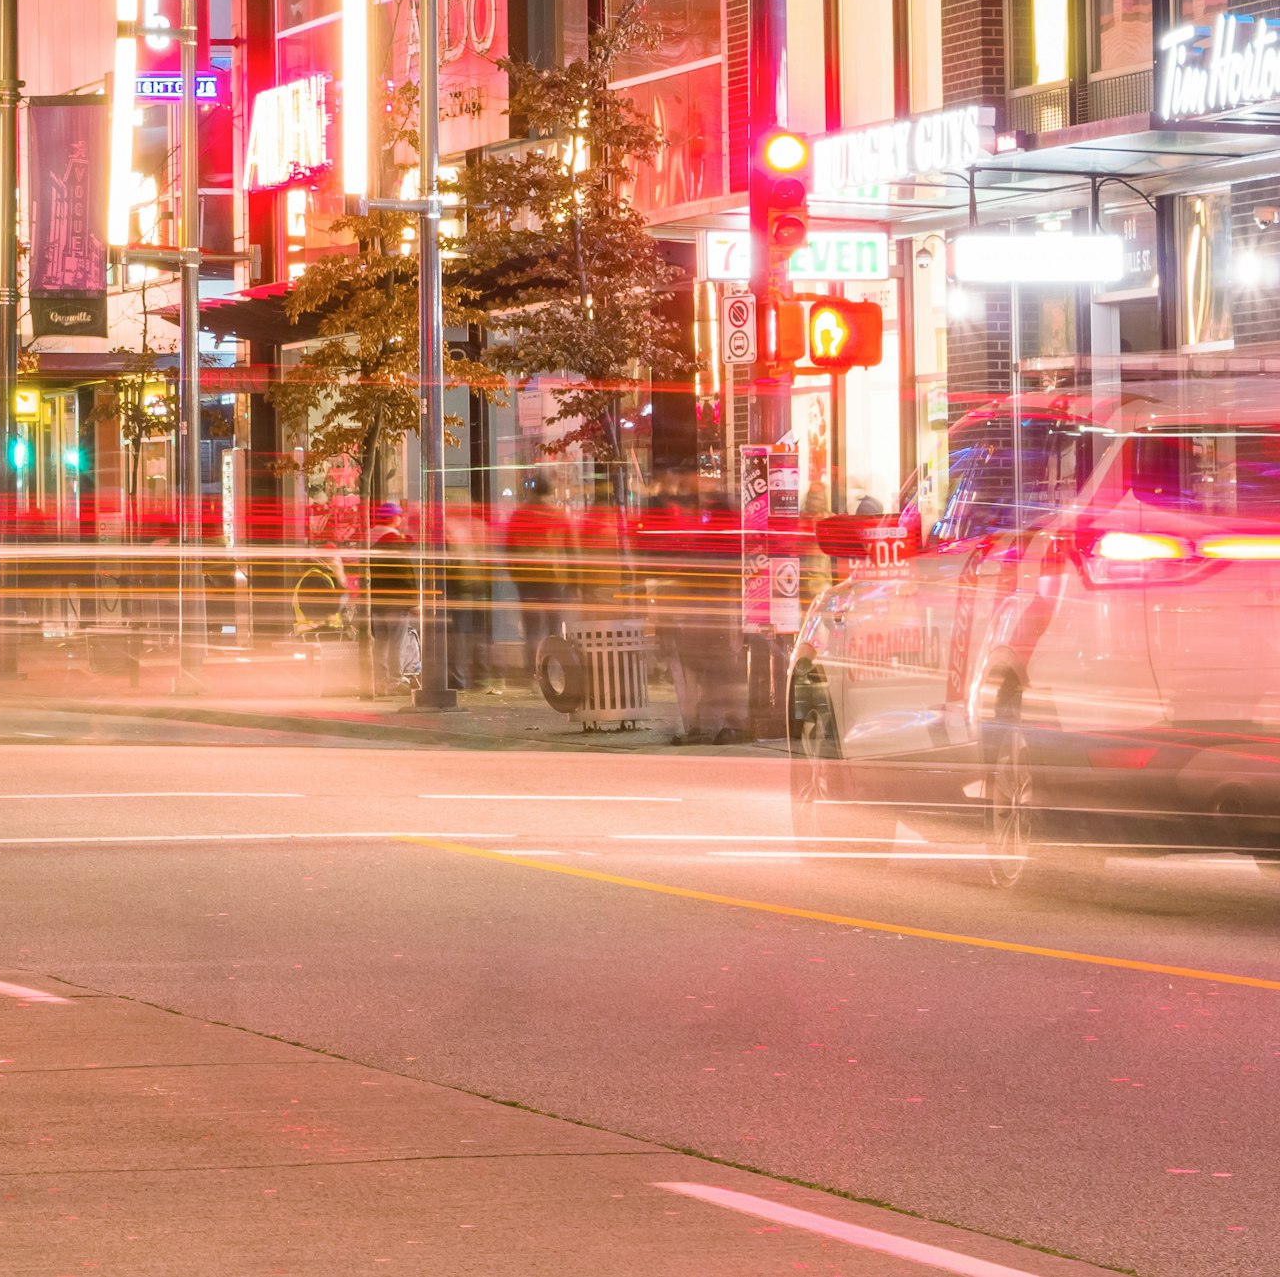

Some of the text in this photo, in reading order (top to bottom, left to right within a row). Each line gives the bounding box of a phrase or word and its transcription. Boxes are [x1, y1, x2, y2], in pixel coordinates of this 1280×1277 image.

[1160, 12, 1280, 122] Tim Horto
[914, 106, 981, 173] GUYS
[72, 167, 86, 251] VOGUE
